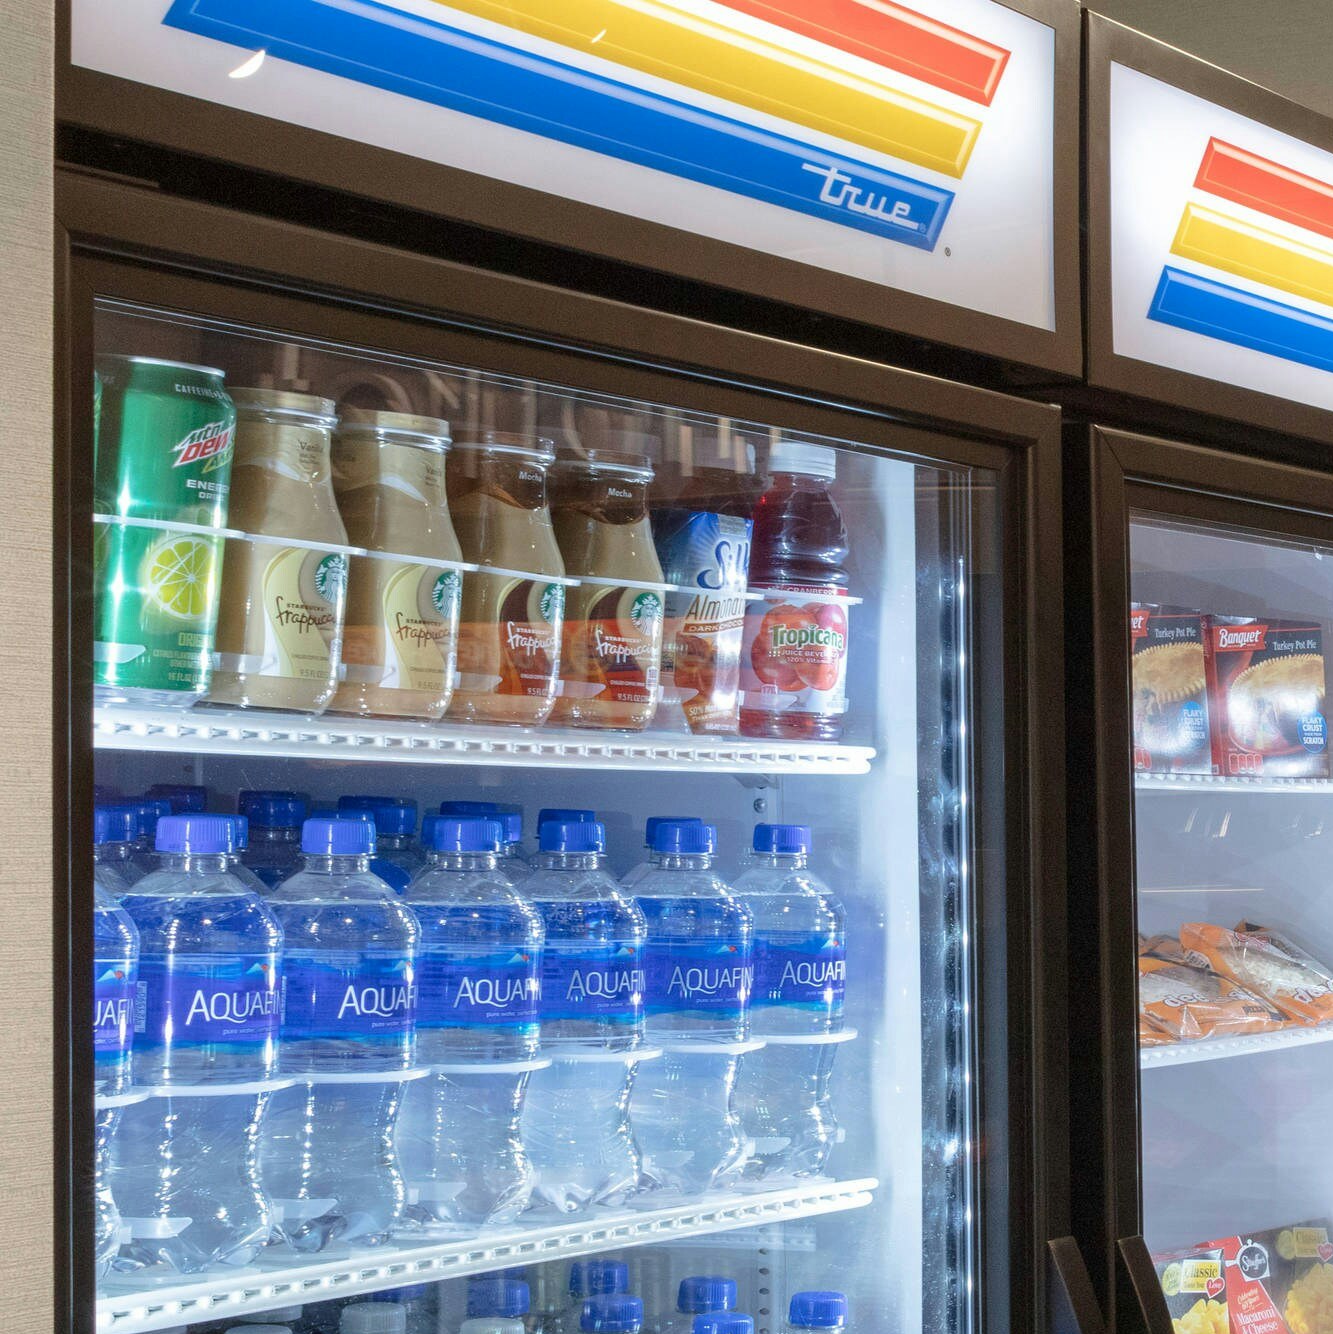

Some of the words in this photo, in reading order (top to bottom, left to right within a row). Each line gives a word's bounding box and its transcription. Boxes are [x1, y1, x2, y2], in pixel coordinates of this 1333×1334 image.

[802, 162, 919, 231] true
[518, 470, 545, 483] Mocha
[608, 486, 634, 500] Mocha
[770, 623, 845, 651] Tropicana
[1219, 628, 1262, 648] Banquet
[1273, 640, 1295, 653] Turkey
[1306, 639, 1317, 650] Pie
[1302, 724, 1324, 733] CRUST
[186, 989, 281, 1026] AQUAFIN
[1236, 1306, 1276, 1326] Macaroni
